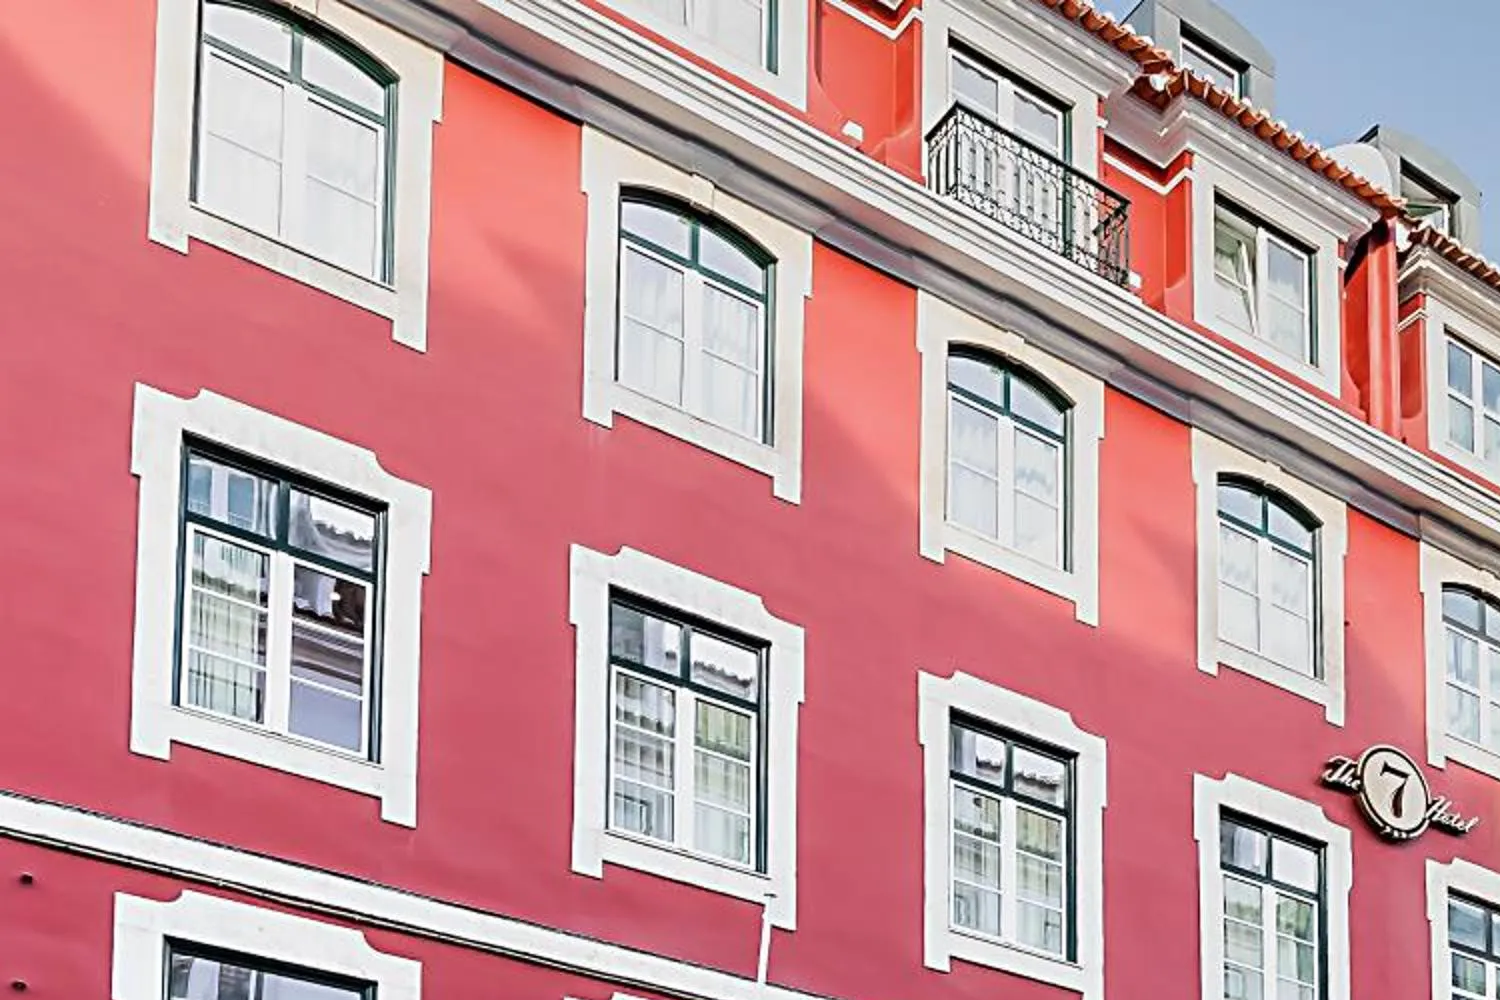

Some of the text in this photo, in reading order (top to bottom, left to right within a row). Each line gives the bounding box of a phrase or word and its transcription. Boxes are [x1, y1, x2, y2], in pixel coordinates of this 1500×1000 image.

[1321, 756, 1479, 833] The 7 Hotel
